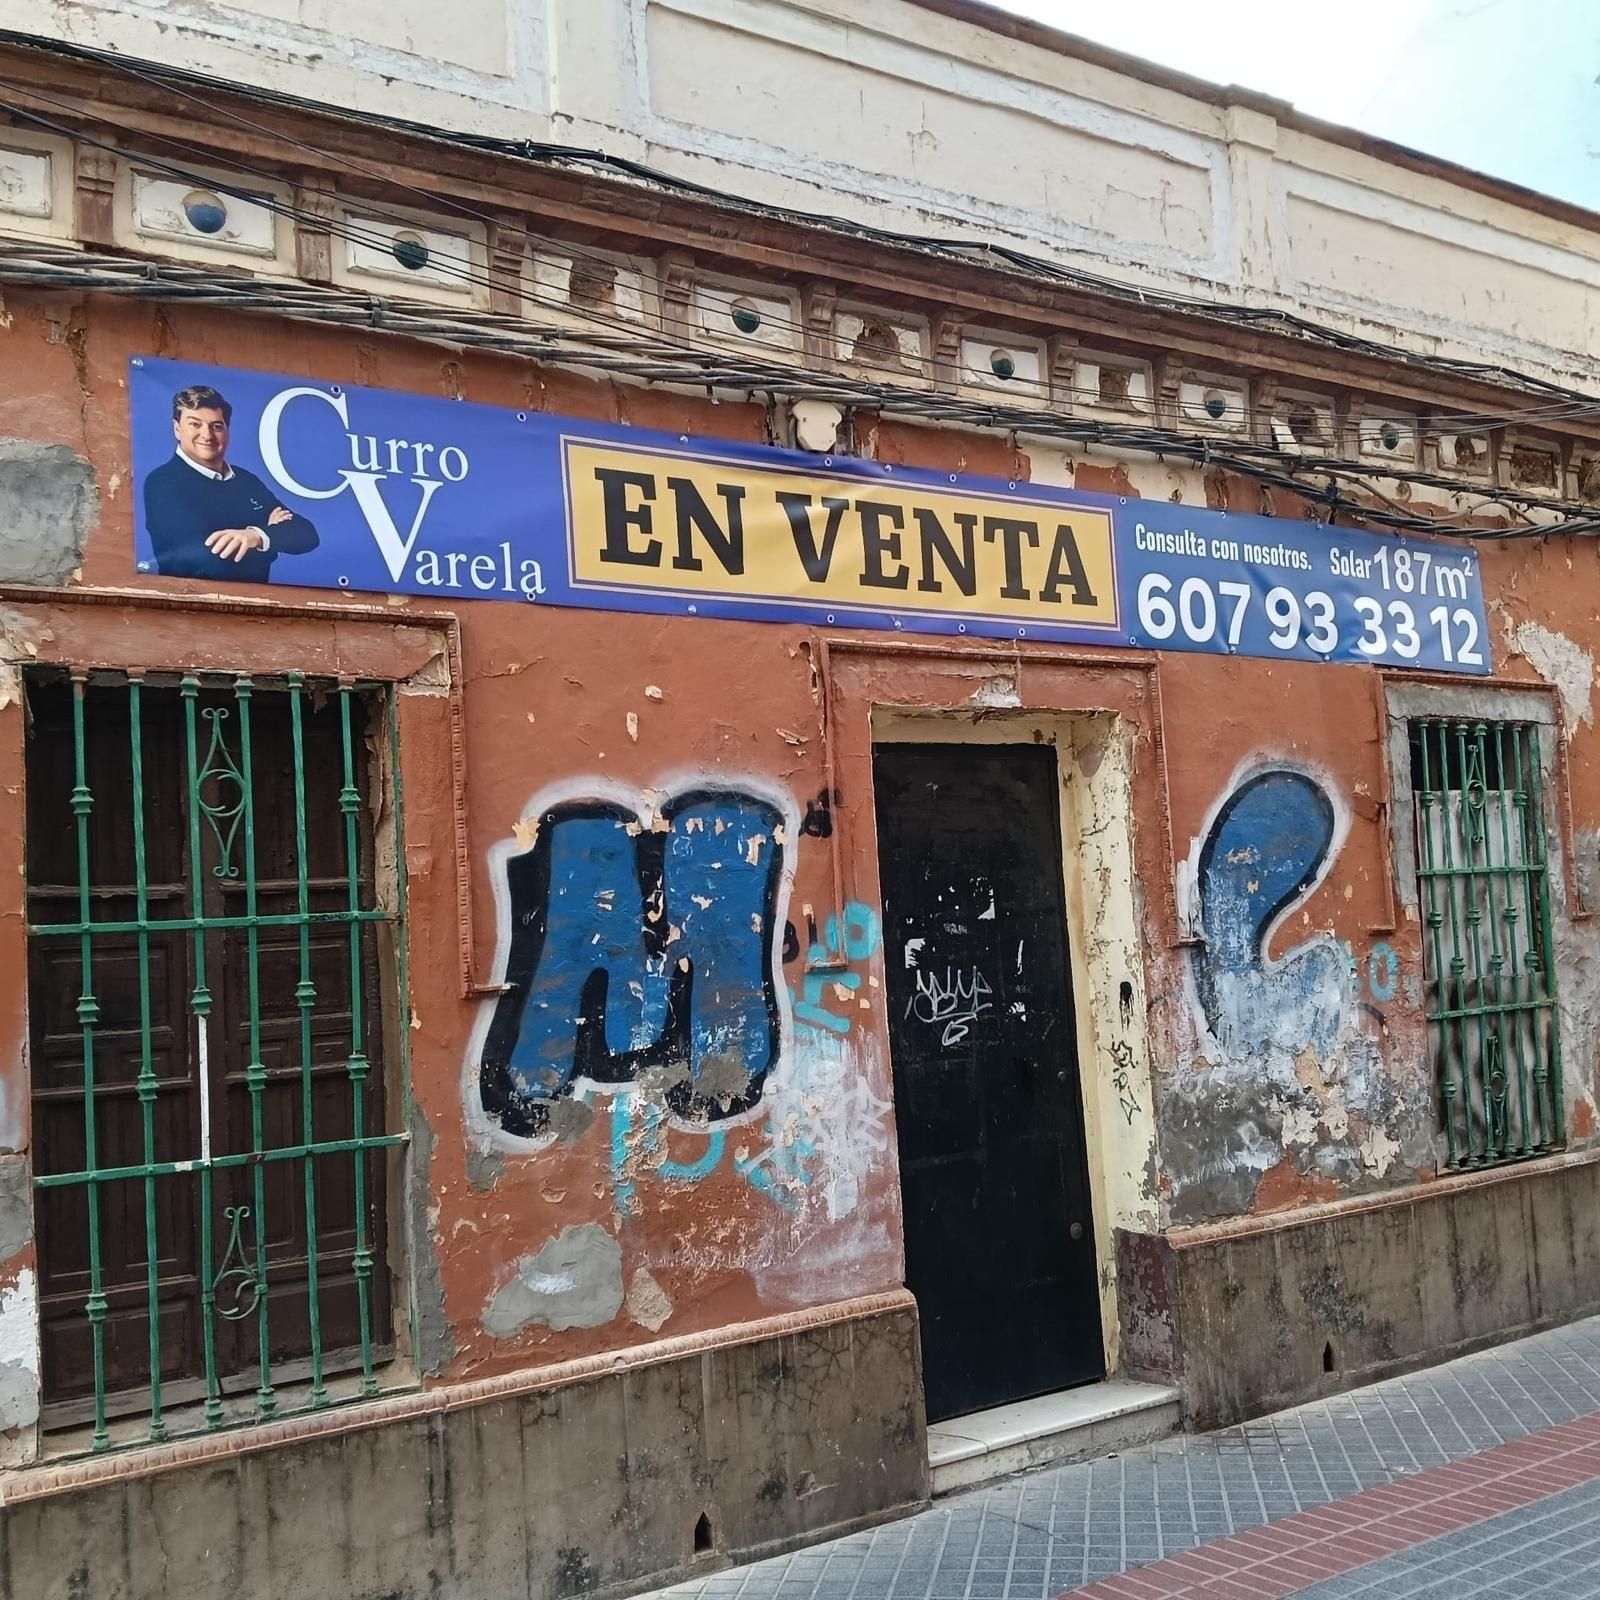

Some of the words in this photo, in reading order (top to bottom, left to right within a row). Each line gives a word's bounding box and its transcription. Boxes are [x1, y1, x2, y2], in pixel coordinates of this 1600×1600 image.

[258, 386, 469, 499] Curro
[338, 469, 546, 595] Varela
[594, 466, 746, 576] EN
[775, 491, 1098, 606] VENTA
[1135, 523, 1206, 557] Consulta
[1211, 539, 1239, 561] con
[1243, 543, 1312, 571] nosotros.
[1330, 547, 1371, 579] Solar
[1137, 572, 1251, 645] 607
[1264, 586, 1339, 653] 93
[1353, 596, 1421, 659] 33
[1430, 606, 1483, 666] 12
